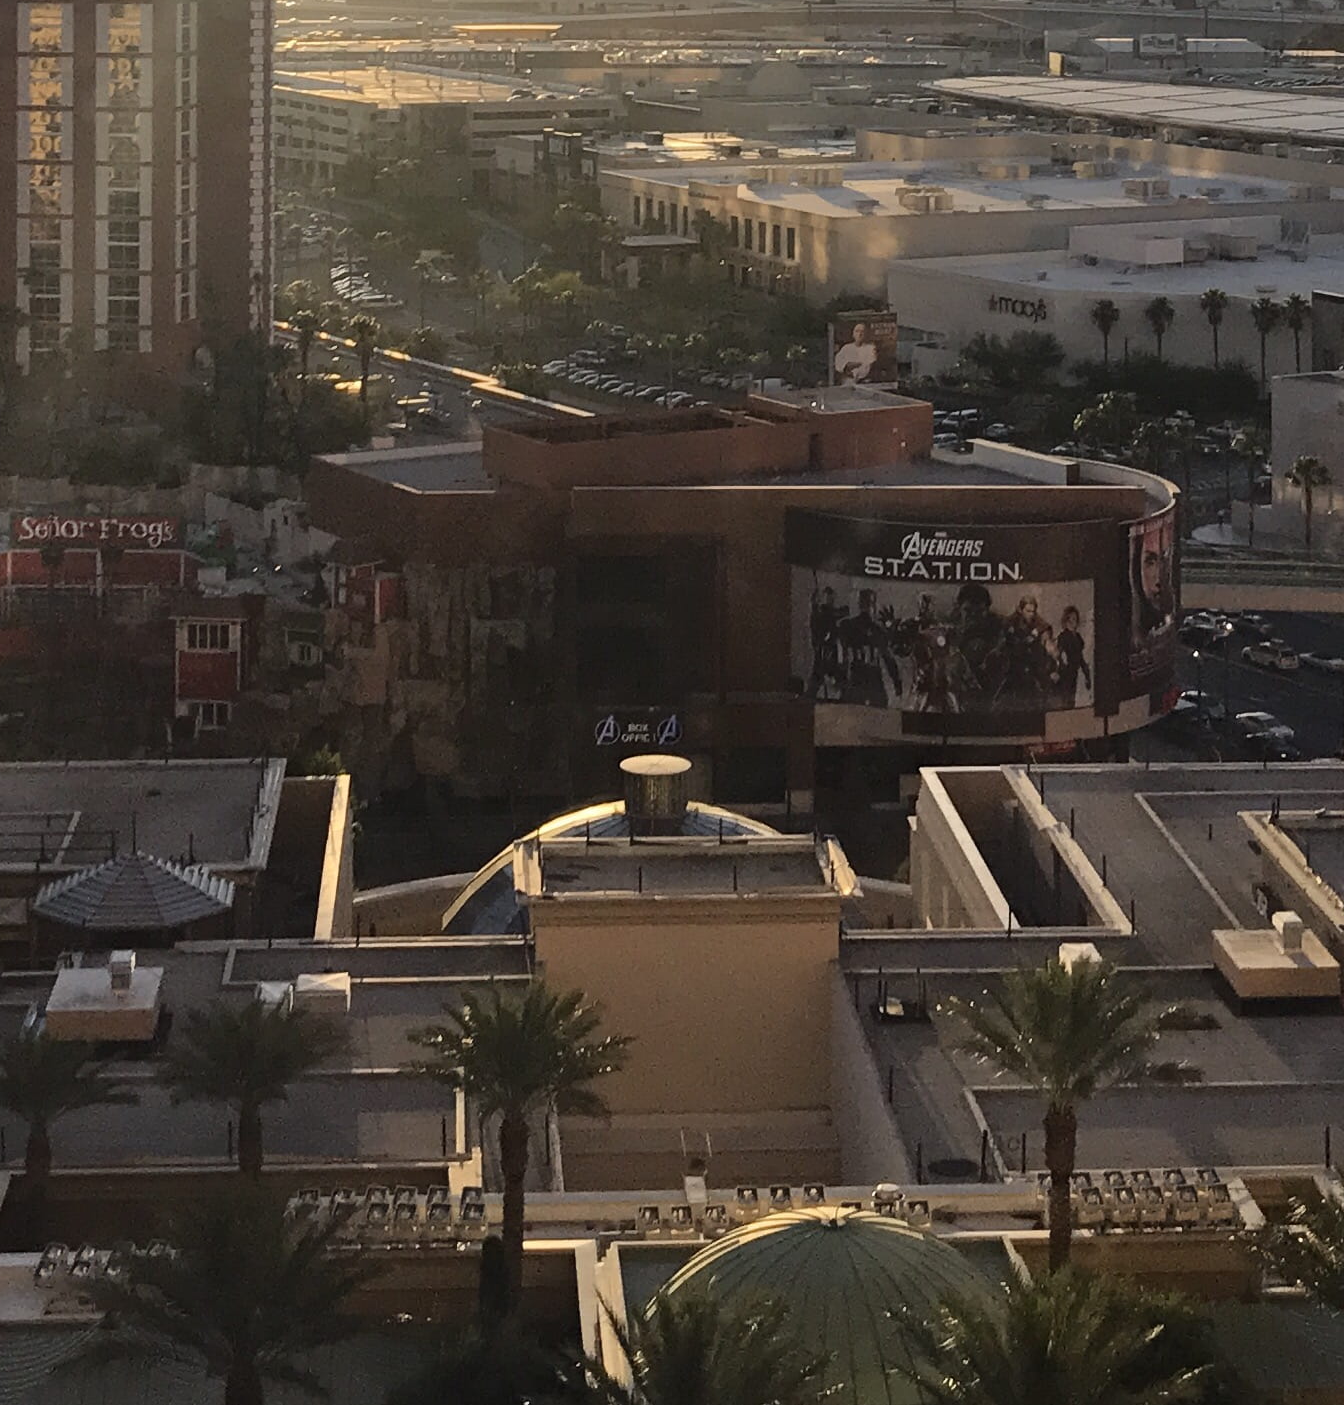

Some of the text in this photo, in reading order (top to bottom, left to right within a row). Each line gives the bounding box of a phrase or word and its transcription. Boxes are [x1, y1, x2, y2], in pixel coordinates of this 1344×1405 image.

[99, 518, 175, 548] Frog's
[864, 555, 1024, 582] S.T.A.T.I.O.N.
[627, 723, 649, 732] BOX
